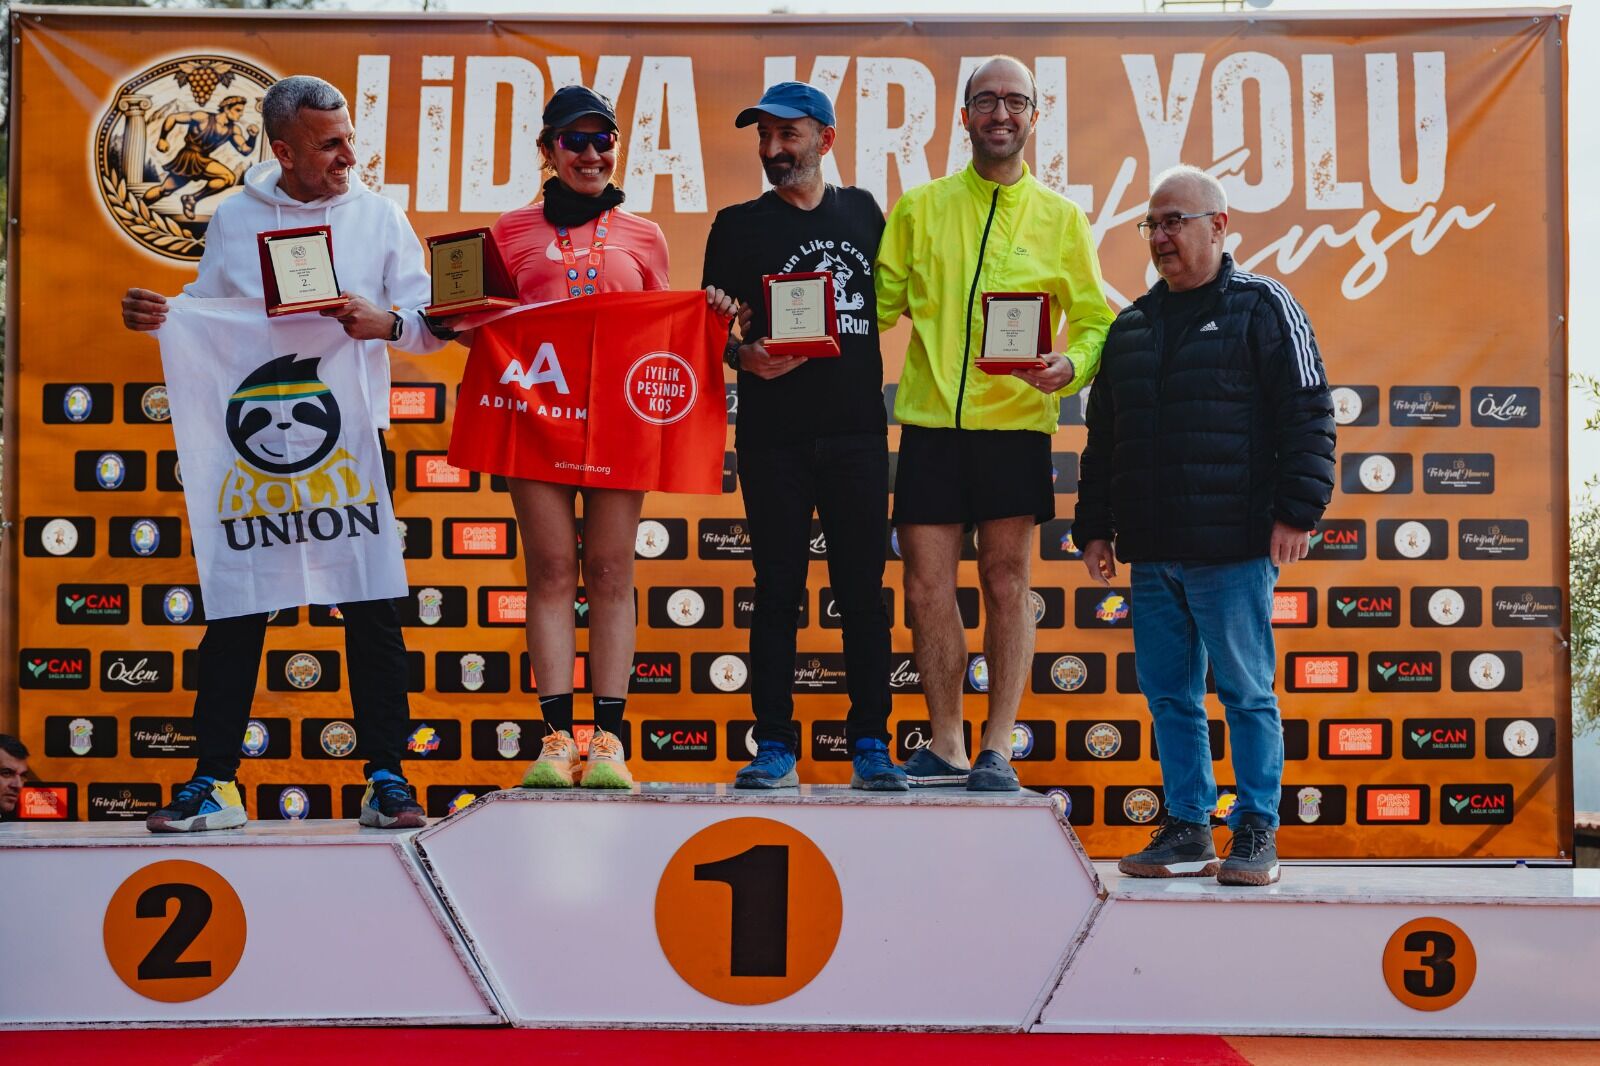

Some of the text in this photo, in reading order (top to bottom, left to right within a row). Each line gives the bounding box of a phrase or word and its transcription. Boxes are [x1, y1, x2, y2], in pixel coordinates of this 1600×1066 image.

[1121, 51, 1447, 212] YOLU
[777, 239, 871, 276] un Like Crazy
[837, 313, 870, 336] Run
[637, 380, 686, 399] PEŞİNDE
[480, 394, 587, 420] ADIM ADIM
[648, 398, 671, 415] KOŞ
[1477, 393, 1528, 421] Özlem
[220, 459, 375, 519] BOLD
[221, 502, 379, 551] UNION
[1323, 529, 1358, 544] CAN
[86, 594, 121, 608] CAN
[1357, 597, 1392, 610] CAN
[48, 658, 83, 672] CAN
[107, 658, 159, 685] Özlem
[636, 663, 672, 677] CAN
[889, 660, 920, 687] lem
[1398, 662, 1433, 675] CAN
[672, 730, 708, 744] CAN
[816, 734, 847, 748] Fotoğra
[1432, 729, 1467, 743] CAN
[1470, 794, 1505, 808] CAN
[694, 845, 789, 977] 1
[136, 883, 212, 980] 2
[1404, 930, 1456, 997] 3
